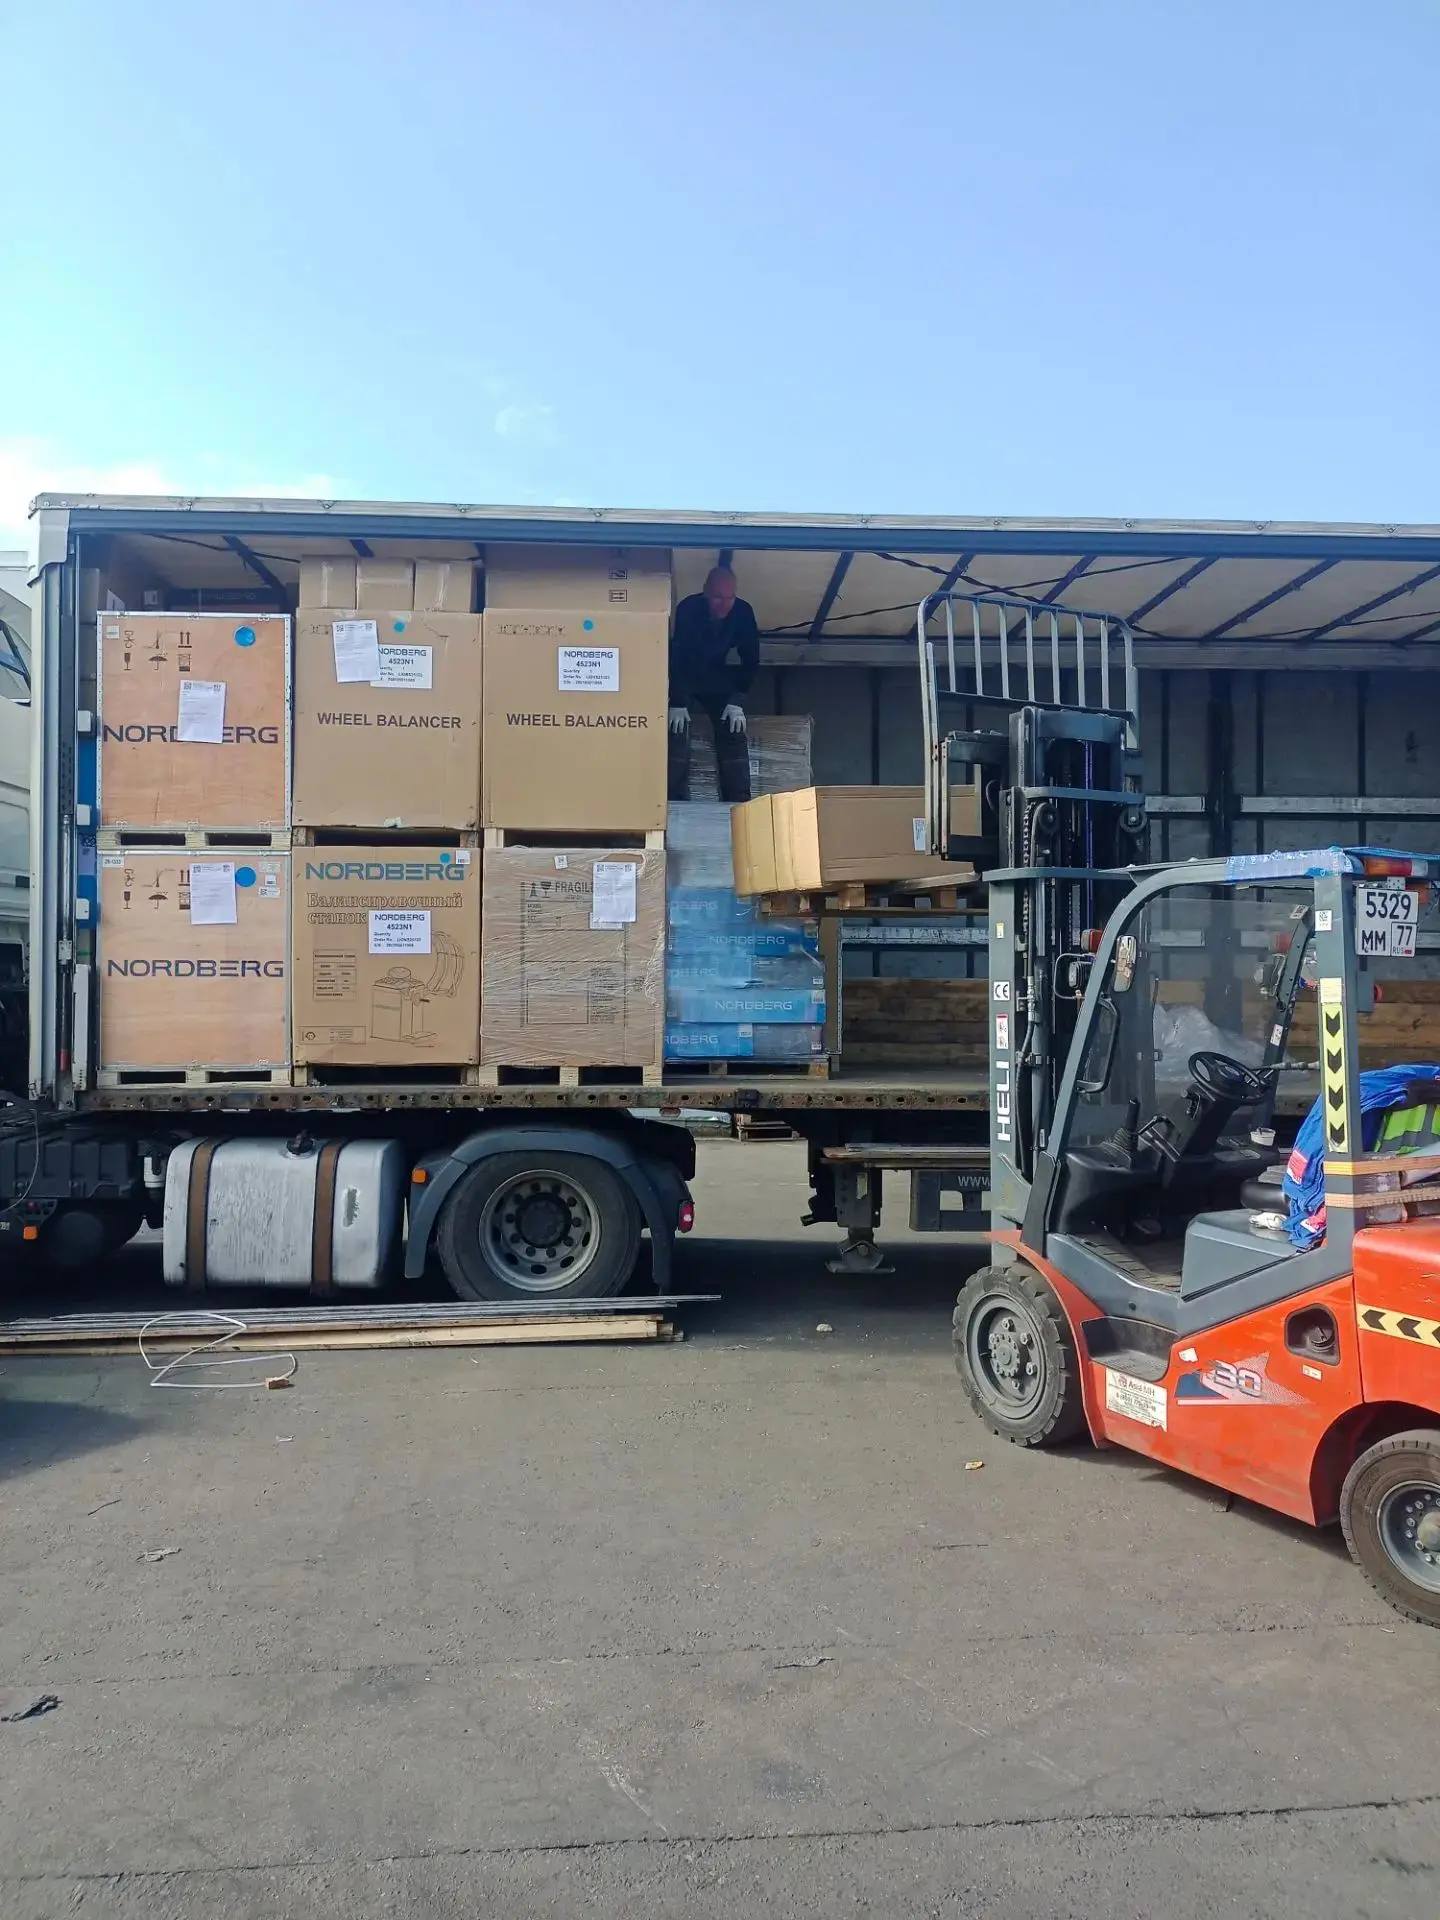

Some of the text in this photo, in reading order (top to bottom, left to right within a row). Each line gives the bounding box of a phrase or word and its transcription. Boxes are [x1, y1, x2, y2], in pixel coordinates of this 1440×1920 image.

[564, 650, 613, 658] NORDBERG
[316, 712, 462, 729] WHEEL BALANCER
[506, 713, 648, 729] WHEEL BALANCER
[103, 724, 279, 744] NORERG
[305, 862, 465, 881] NORDBERG
[306, 892, 464, 909] Балансировочный
[1365, 891, 1412, 920] 5329
[307, 911, 368, 925] станок
[374, 913, 425, 921] NORDBERG
[709, 935, 786, 945] NORDBERG
[1361, 929, 1386, 951] MM
[1396, 925, 1413, 946] 77
[107, 959, 284, 977] NORDBERG
[715, 1000, 793, 1011] NORDBERG
[996, 1060, 1012, 1143] HELI
[1214, 1359, 1262, 1398] 30
